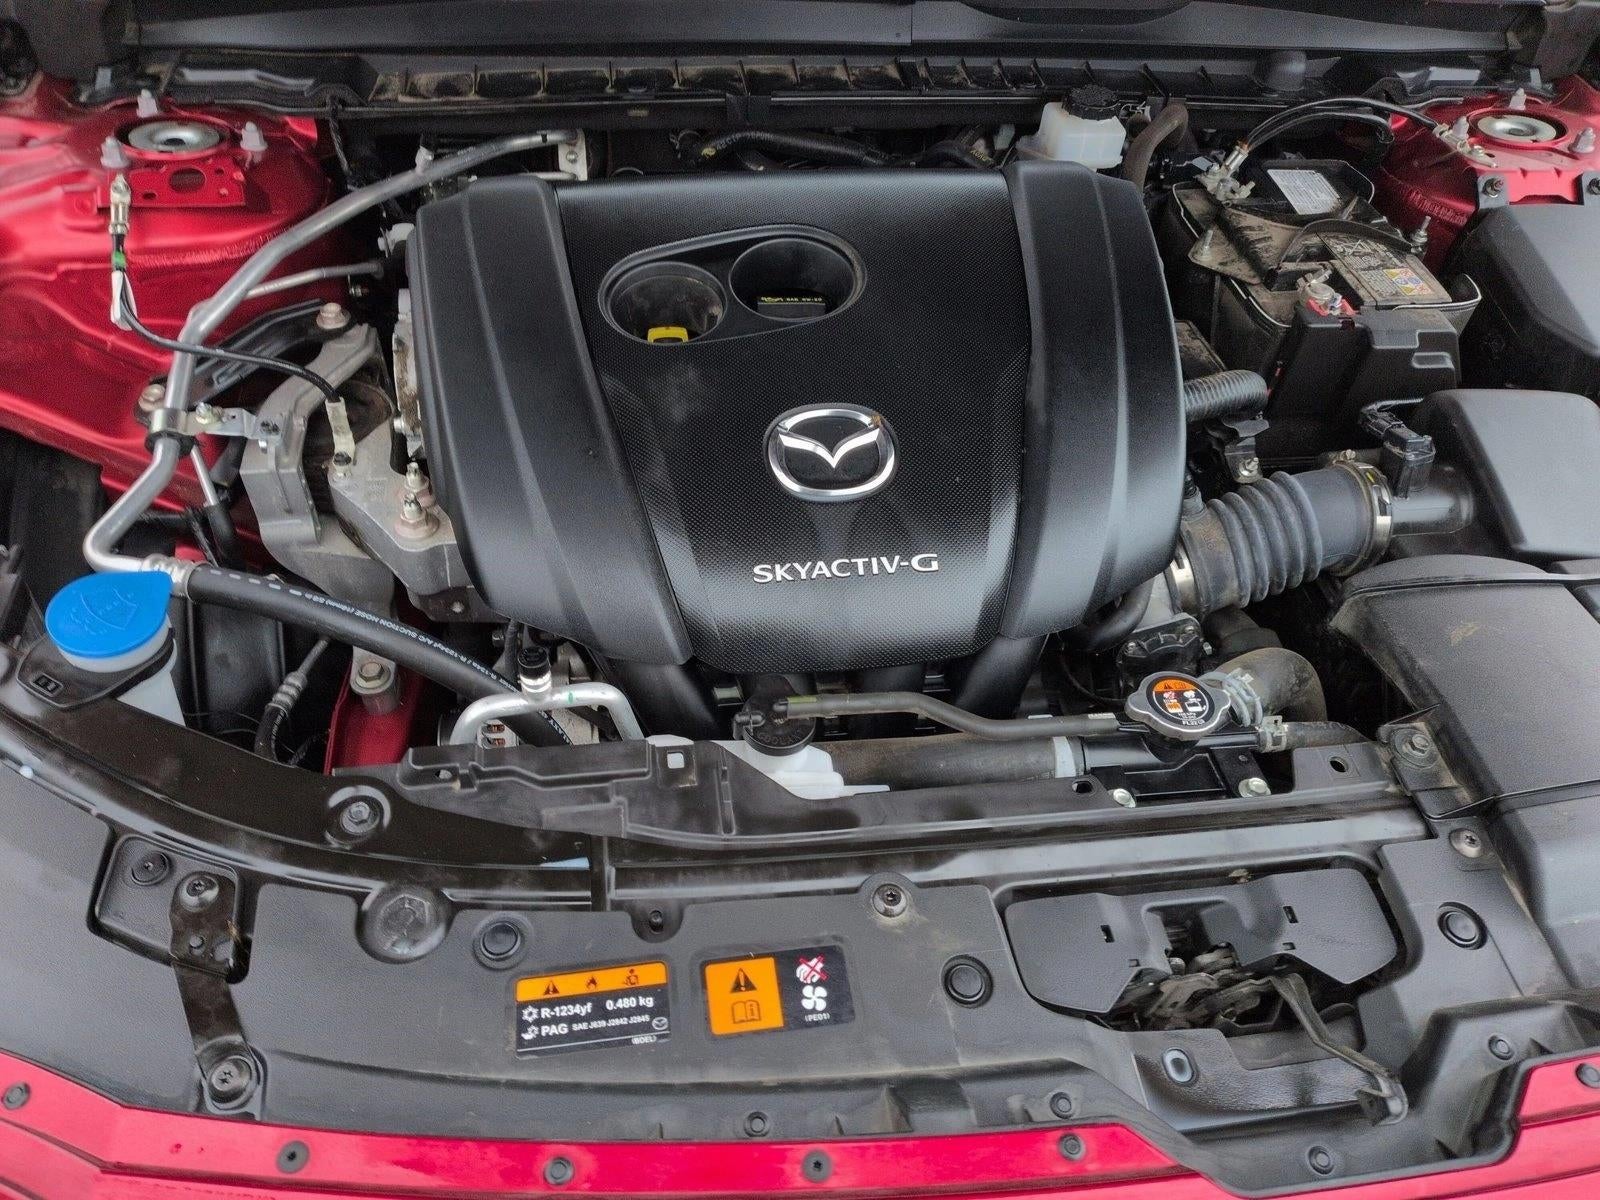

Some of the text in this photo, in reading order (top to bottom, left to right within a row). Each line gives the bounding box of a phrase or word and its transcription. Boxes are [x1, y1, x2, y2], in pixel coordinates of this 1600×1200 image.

[753, 553, 940, 584] SKYACTIV-G
[354, 609, 380, 623] HOSE
[380, 618, 418, 639] SUCTION
[540, 995, 654, 1019] R-1234yf 0.480 kg
[540, 1023, 569, 1037] PAG
[572, 1022, 589, 1031] SAE
